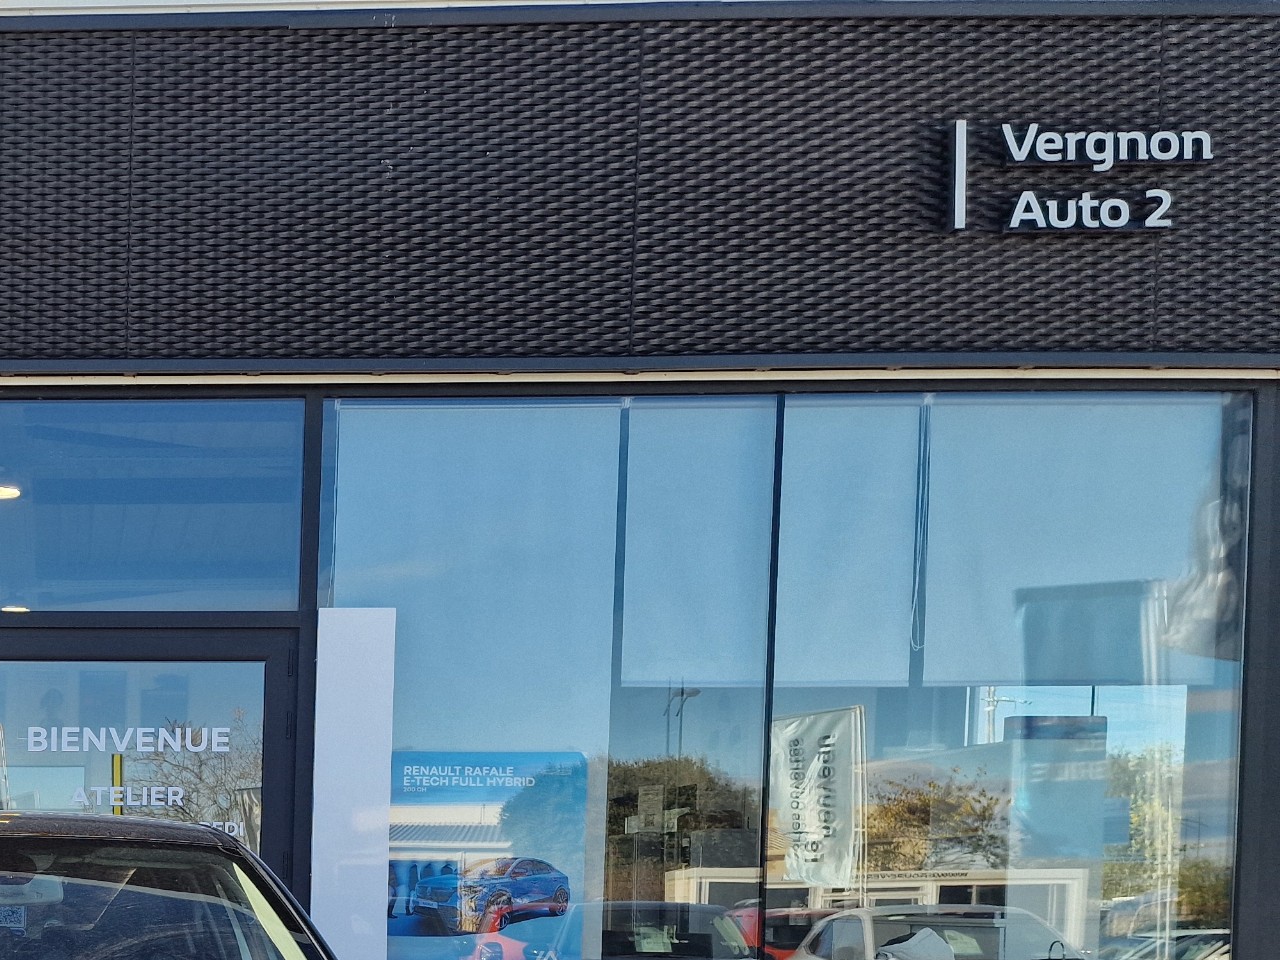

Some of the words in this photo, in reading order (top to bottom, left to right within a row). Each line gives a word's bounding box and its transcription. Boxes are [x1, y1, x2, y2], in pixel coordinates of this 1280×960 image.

[1002, 123, 1214, 172] Vergnon
[1009, 191, 1130, 228] Auto
[1144, 189, 1172, 228] 2
[27, 727, 230, 752] BIENVENUE
[403, 765, 461, 776] RENAULT
[464, 766, 514, 776] RAFALE
[403, 776, 449, 786] E-TECH
[451, 777, 484, 787] FULL
[486, 777, 535, 787] HYBRID
[70, 786, 184, 806] ATELIER
